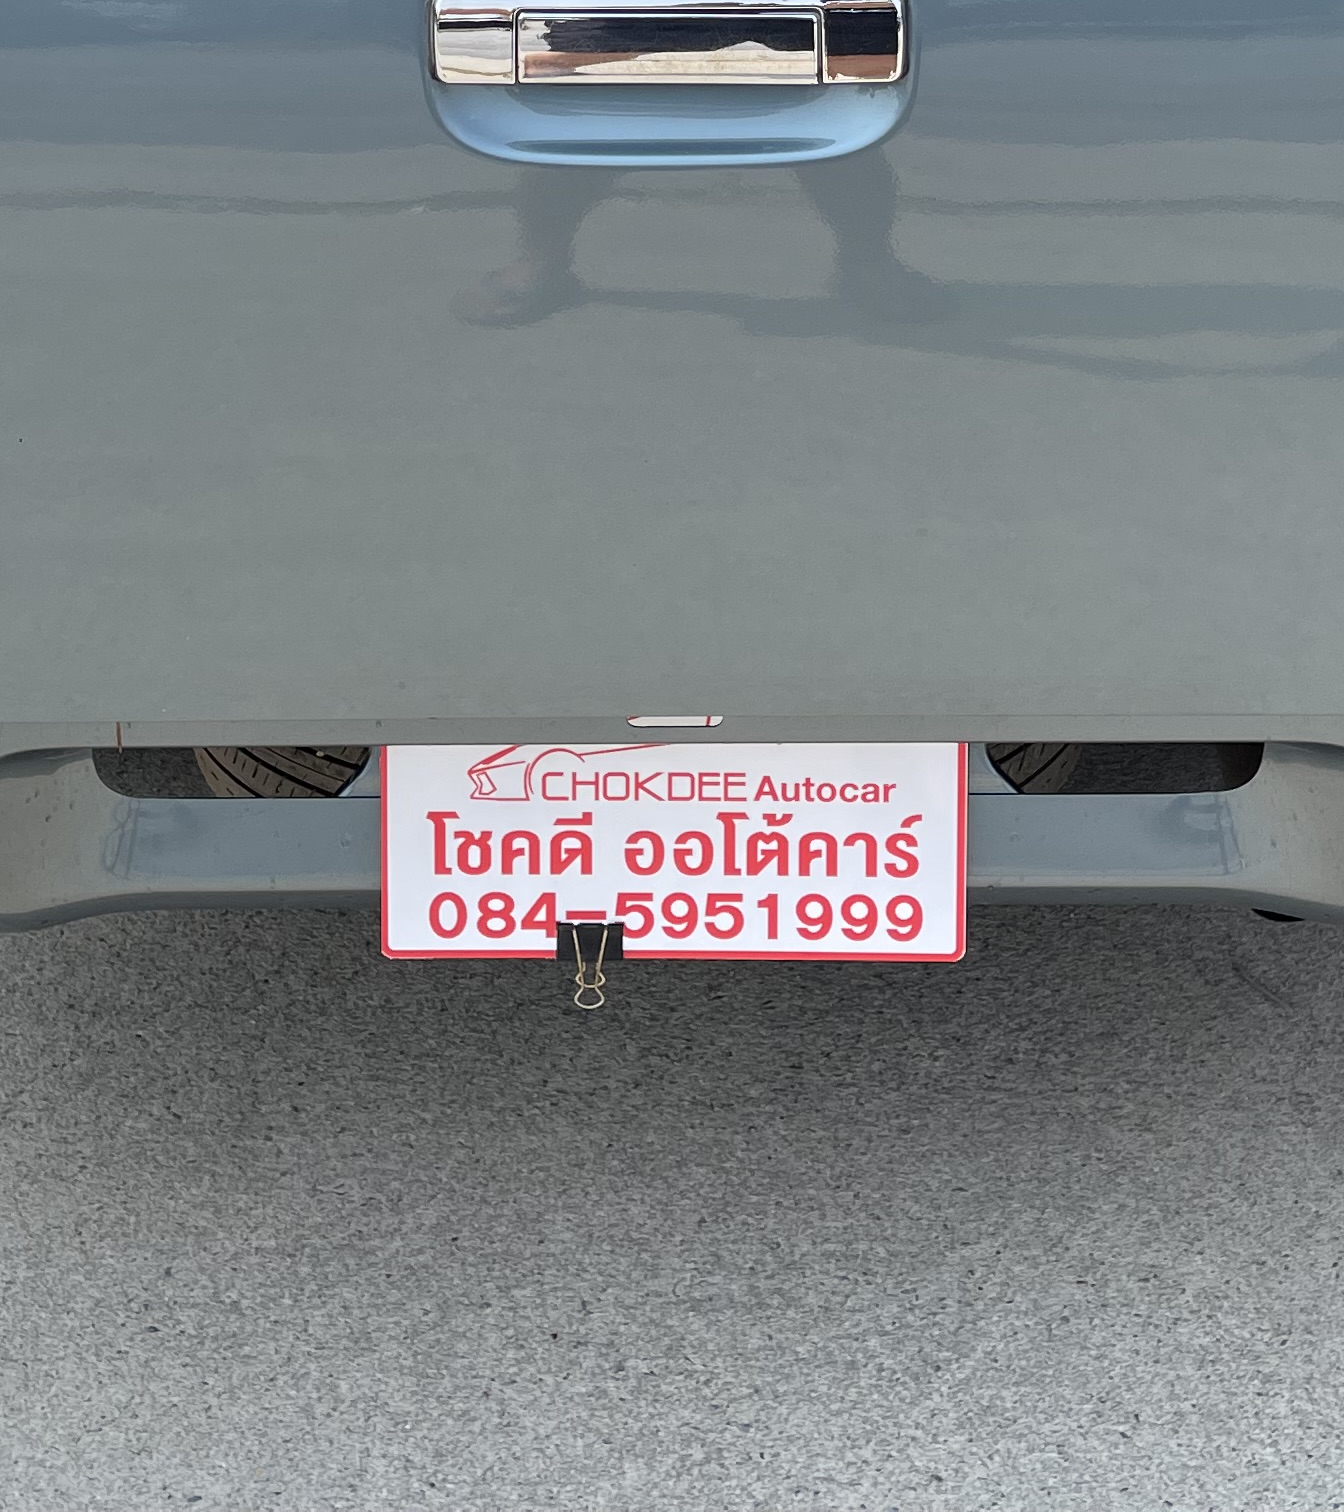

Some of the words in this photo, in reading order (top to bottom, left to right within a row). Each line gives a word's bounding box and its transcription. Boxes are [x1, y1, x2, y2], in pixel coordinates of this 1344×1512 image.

[540, 771, 748, 802] CHOKDEE
[752, 775, 897, 804] Autocar
[425, 810, 595, 877] โชคดี
[623, 811, 924, 879] ออโต้คาร์
[428, 891, 925, 942] 084-5951999
